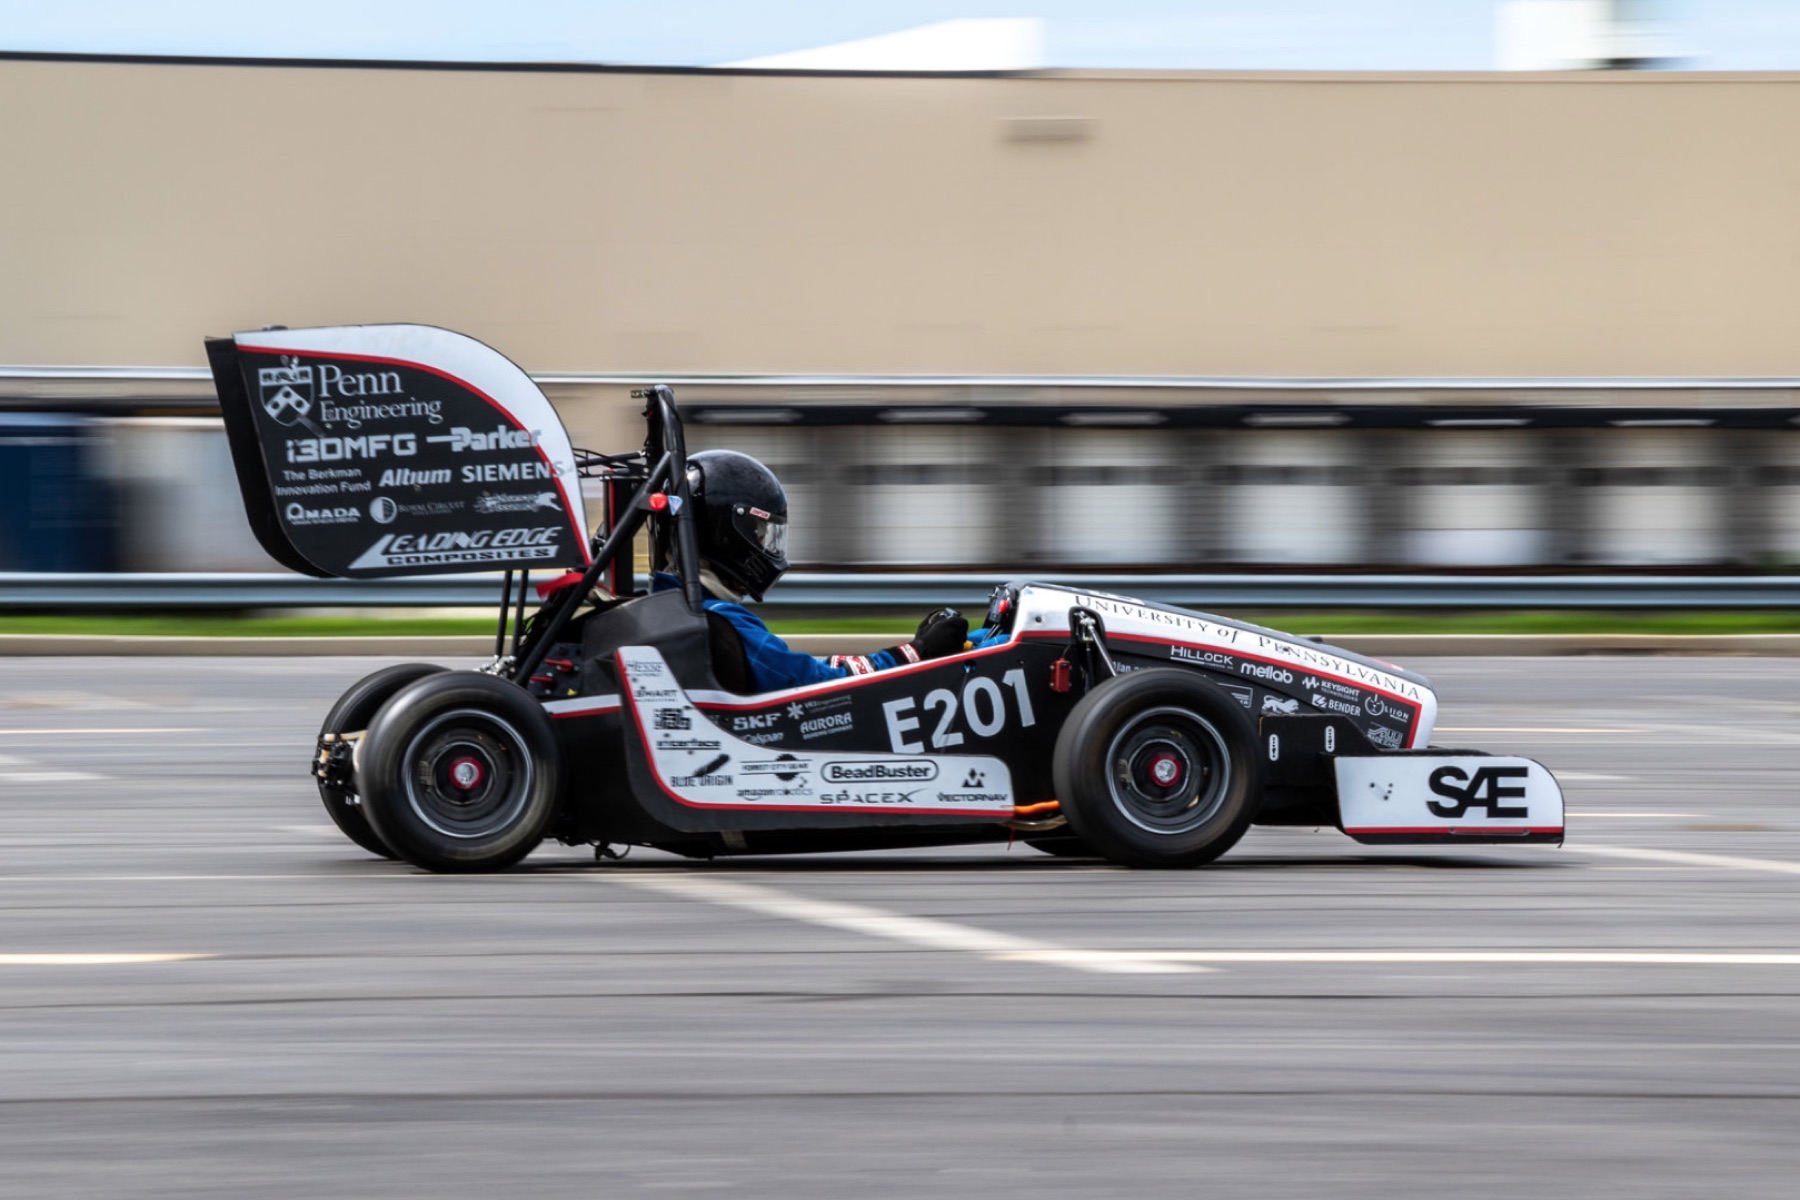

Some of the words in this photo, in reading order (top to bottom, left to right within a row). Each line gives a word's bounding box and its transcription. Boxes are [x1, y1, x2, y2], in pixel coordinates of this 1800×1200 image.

[317, 364, 404, 397] Penn
[320, 396, 443, 429] Engineering
[449, 425, 542, 452] Parker
[283, 470, 306, 480] The
[461, 461, 566, 483] SIEMENS
[275, 483, 338, 496] Innovation
[340, 480, 371, 493] Fund
[366, 530, 491, 558] LEADING
[490, 527, 564, 546] EDGE
[386, 548, 549, 566] COMPOSITES
[1075, 595, 1209, 632] UNIVERSITY
[1259, 636, 1420, 701] PENNSYLVANIA
[1321, 680, 1360, 697] KEYSIGHT
[882, 668, 1036, 755] E201
[1328, 699, 1361, 717] BENDER
[732, 712, 782, 732] SKF
[800, 711, 853, 734] AURORA
[671, 775, 695, 787] BLUE
[831, 765, 931, 779] BeadBuster
[1426, 766, 1529, 818] SAE
